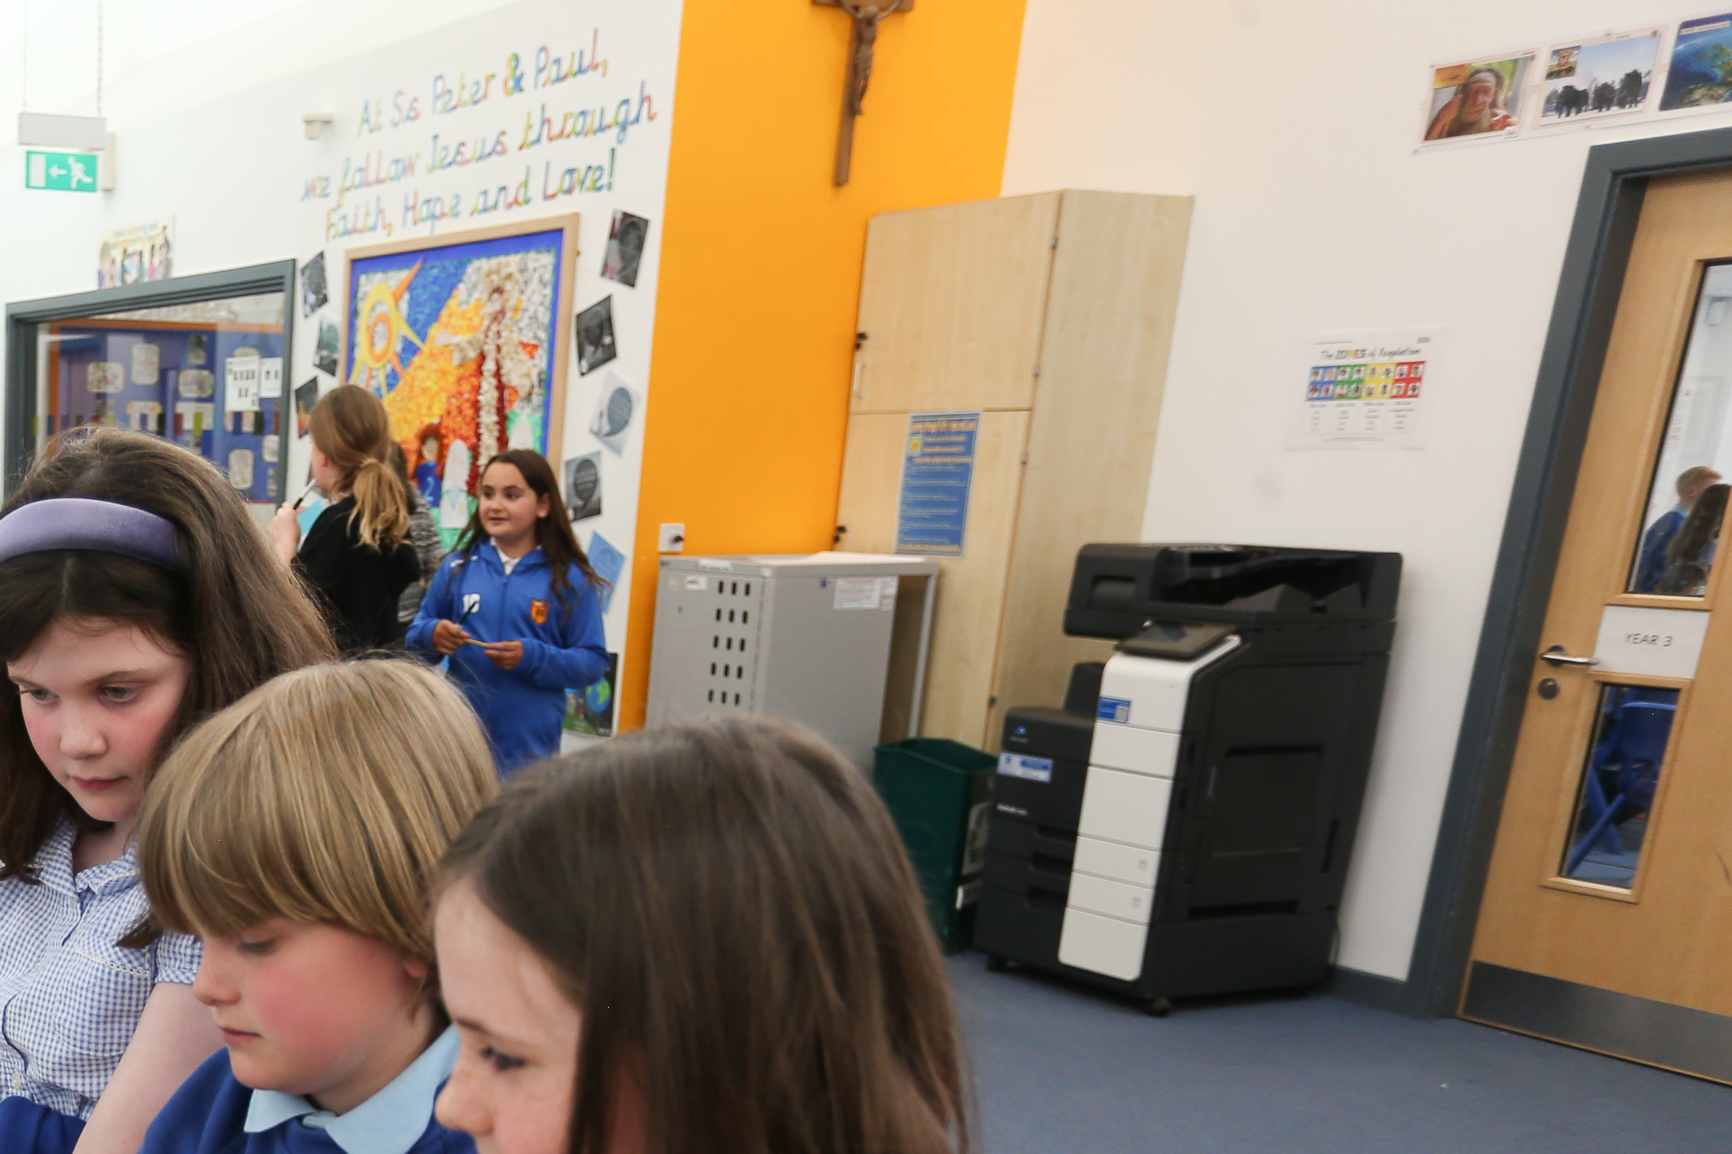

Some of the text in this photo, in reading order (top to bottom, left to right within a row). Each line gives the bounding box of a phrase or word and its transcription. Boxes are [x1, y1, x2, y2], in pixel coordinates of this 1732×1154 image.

[358, 27, 609, 136] At Ss Peter & Paul,
[337, 148, 421, 208] follow
[427, 129, 509, 174] Jesus
[518, 79, 658, 151] through
[325, 147, 617, 243] Faith, Hope and Love!
[1624, 632, 1673, 647] YEAR 3
